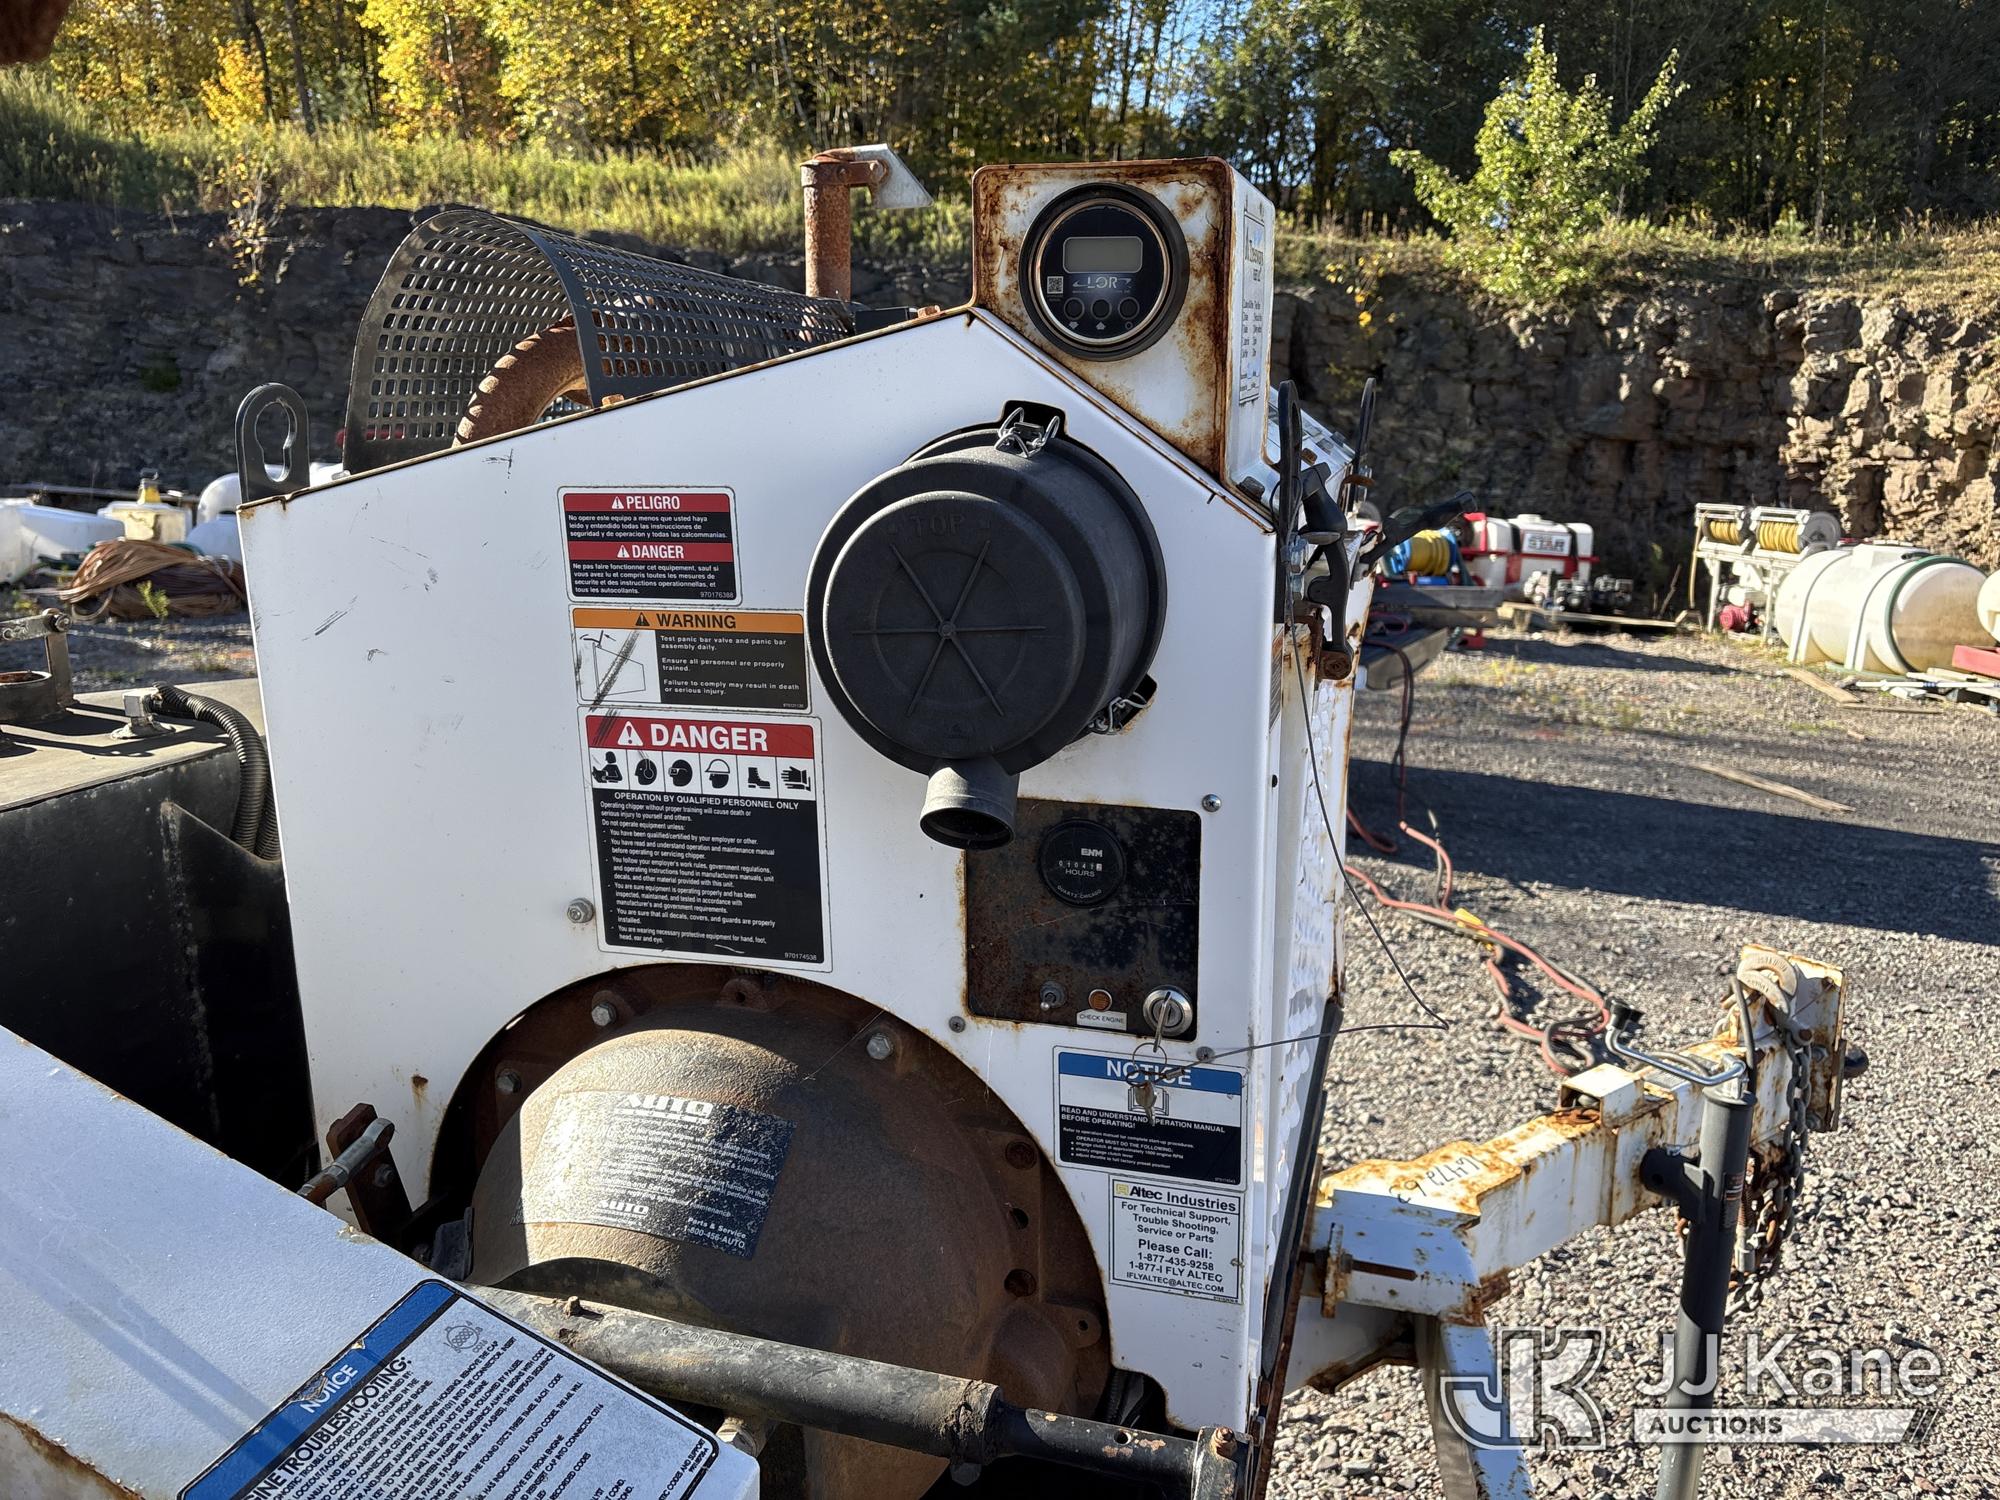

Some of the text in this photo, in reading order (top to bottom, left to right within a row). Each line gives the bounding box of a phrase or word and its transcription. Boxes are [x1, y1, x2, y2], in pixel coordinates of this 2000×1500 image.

[626, 495, 680, 509] PELIGRO
[911, 513, 968, 537] TOP
[632, 544, 684, 558] DANGER
[619, 571, 645, 579] compris
[656, 613, 736, 628] WARNING
[661, 657, 687, 666] Ensure
[700, 680, 726, 688] comply
[650, 723, 768, 752] DANGER
[599, 800, 624, 810] Operating
[625, 802, 644, 810] chipper
[682, 806, 702, 814] training
[614, 791, 798, 809] OPERATION BY QUALIFIED PERSONNEL ONLY
[1065, 868, 1096, 878] HOURS
[1079, 1013, 1125, 1024] CHECK ENGINE
[1106, 1059, 1191, 1086] NOTICE
[1061, 1106, 1080, 1115] READ
[1099, 1111, 1148, 1122] UNDERSTAND
[1153, 1117, 1191, 1128] PERATION
[1193, 1122, 1224, 1132] MANUAL
[1061, 1113, 1135, 1128] BEFORE OPERATING!
[1129, 1185, 1235, 1212] Altec Industries
[1121, 1201, 1230, 1226] For Technical Support,
[1132, 1212, 1218, 1235] Trouble Shooting,
[687, 1217, 708, 1228] Parts
[718, 1225, 747, 1239] Service
[1137, 1224, 1213, 1243] Service or Parts
[1138, 1238, 1211, 1259] Please Call:
[1138, 1251, 1213, 1271] 1-877-435-9258
[1129, 1260, 1222, 1283] 1-877-I FLY ALTEC
[1126, 1272, 1225, 1293] IFLYALTEC@ALTEC.COM
[300, 1364, 359, 1414] NOTICE
[276, 1354, 413, 1477] TROUBLESHOOTING:
